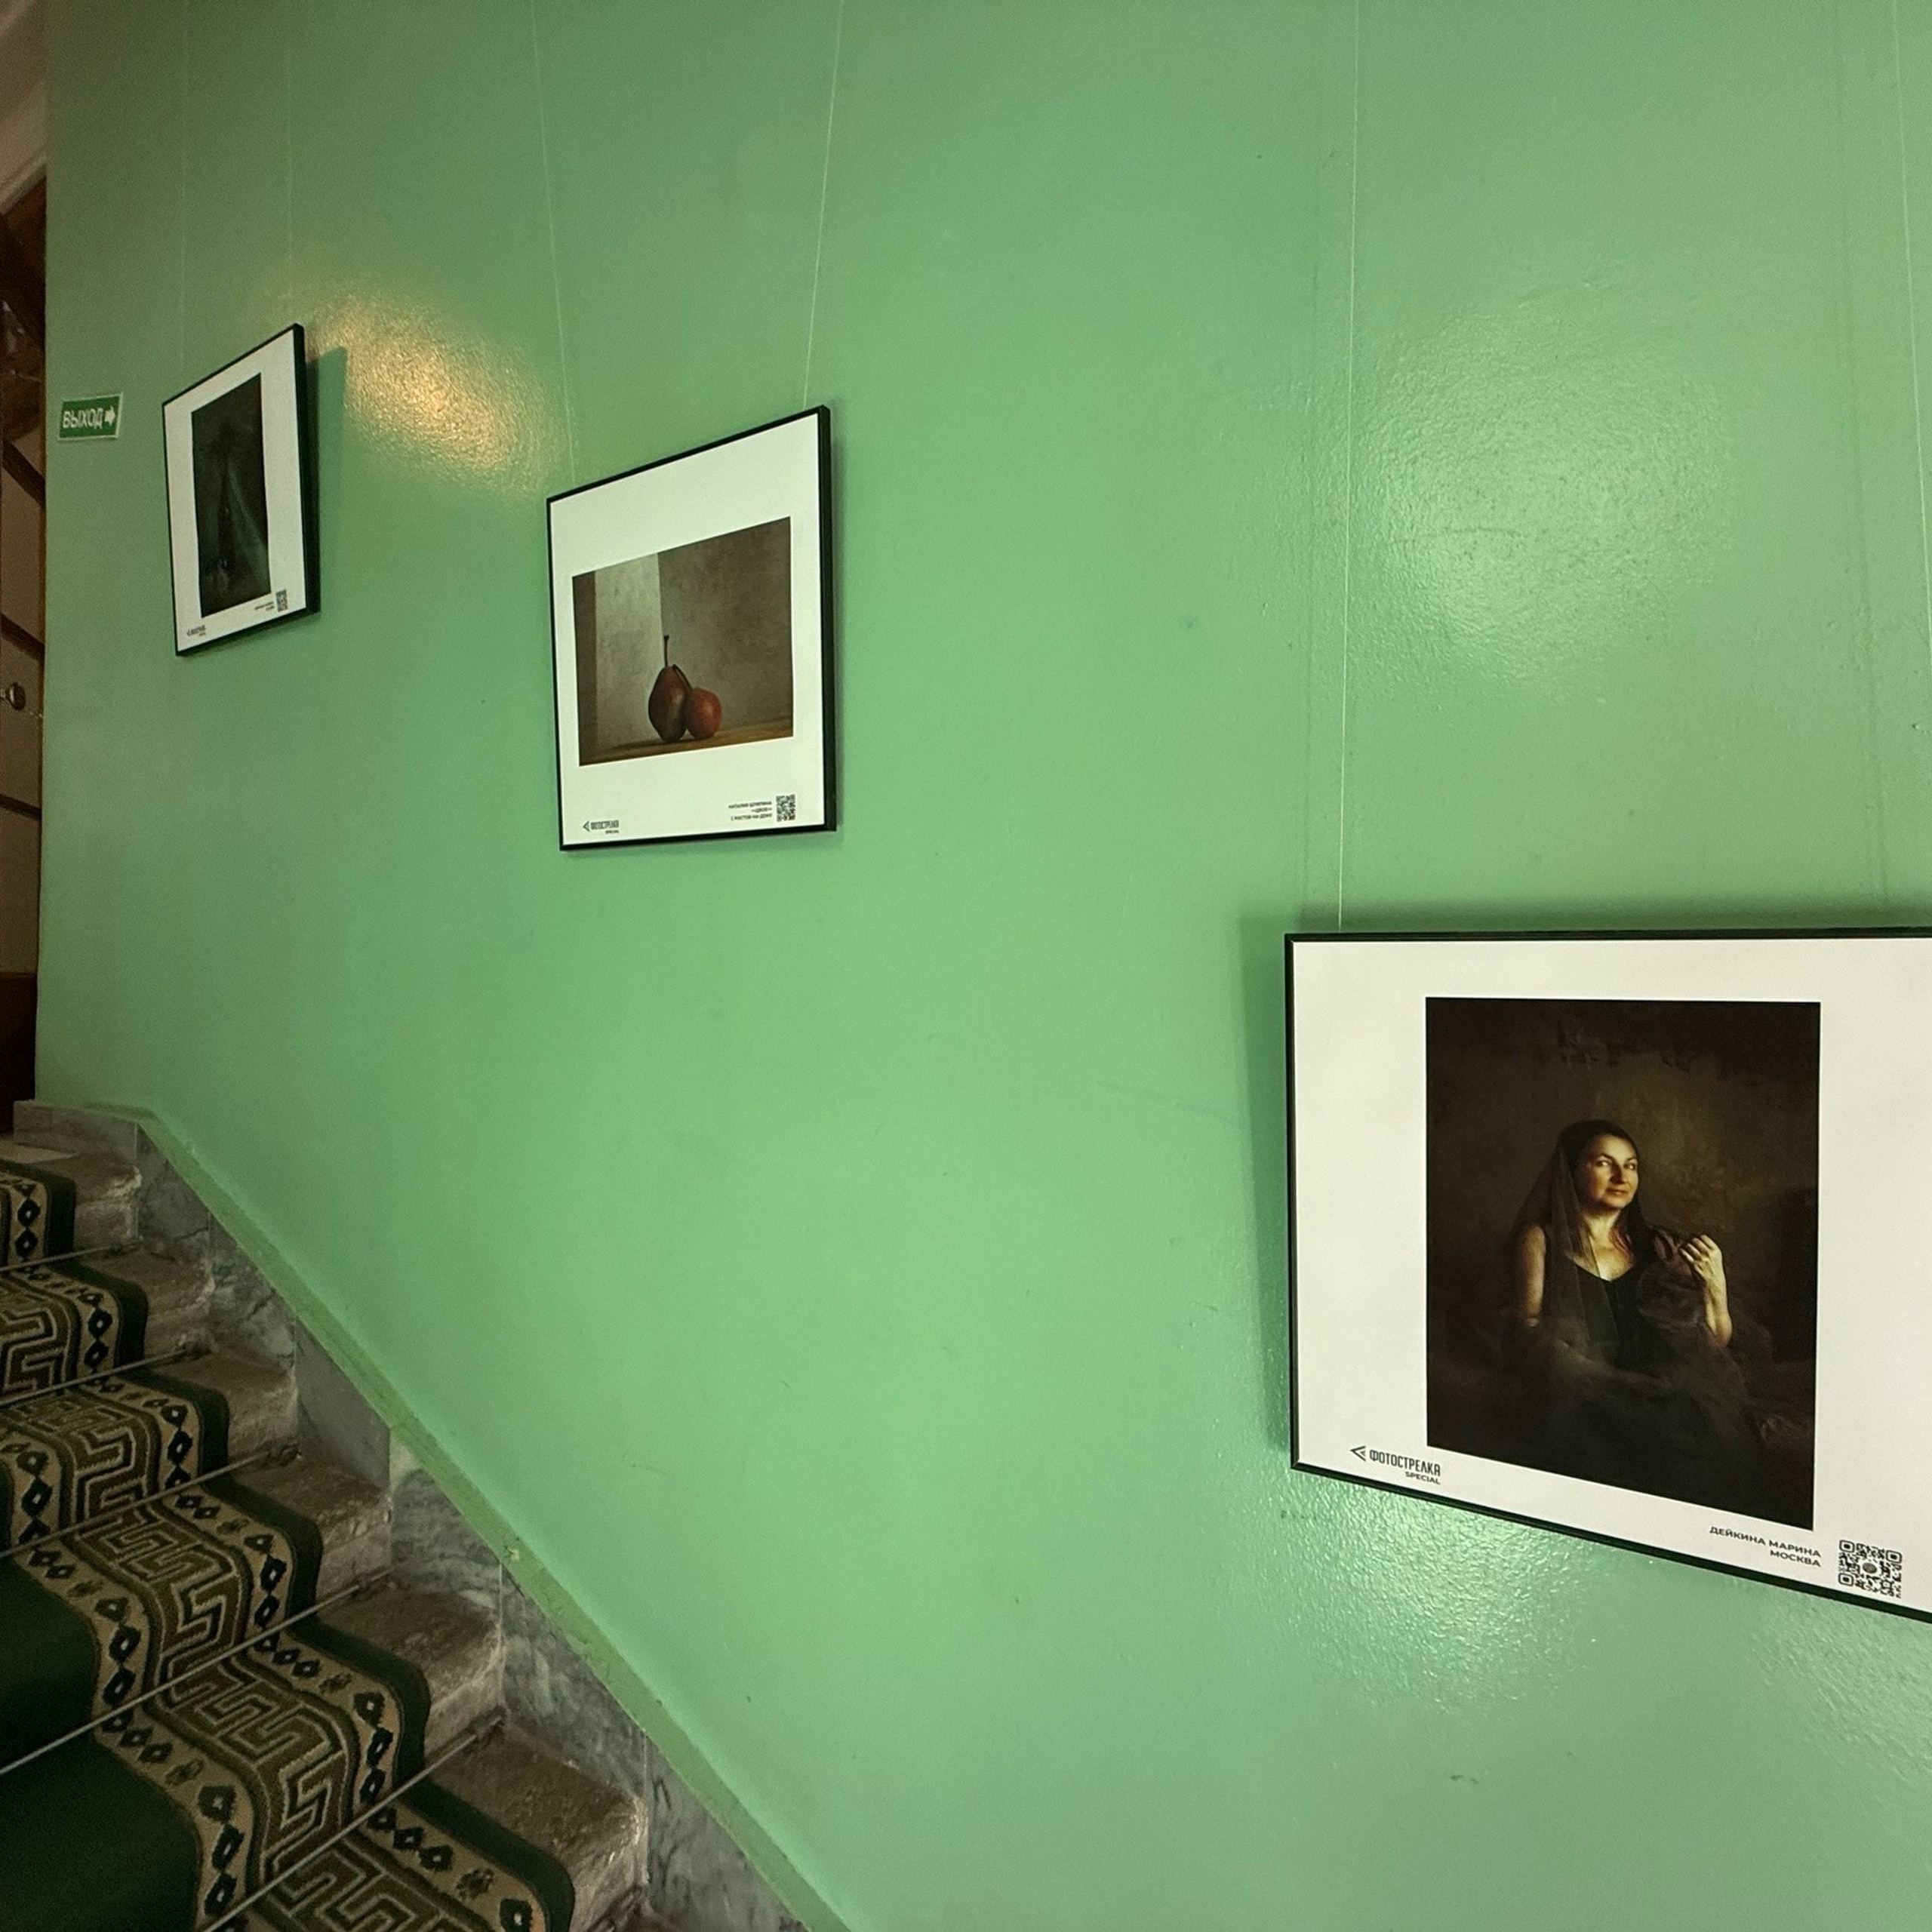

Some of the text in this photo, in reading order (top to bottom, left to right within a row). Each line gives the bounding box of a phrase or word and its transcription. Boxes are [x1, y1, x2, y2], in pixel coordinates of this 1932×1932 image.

[63, 408, 104, 429] ВЫХОД
[1369, 1449, 1441, 1477] ФОТОСТРЕЛКА
[1405, 1471, 1441, 1485] SPECIAL
[1709, 1526, 1822, 1558] ДЕЙКИНА МАРИНА
[1770, 1549, 1822, 1567] МОСКВА
